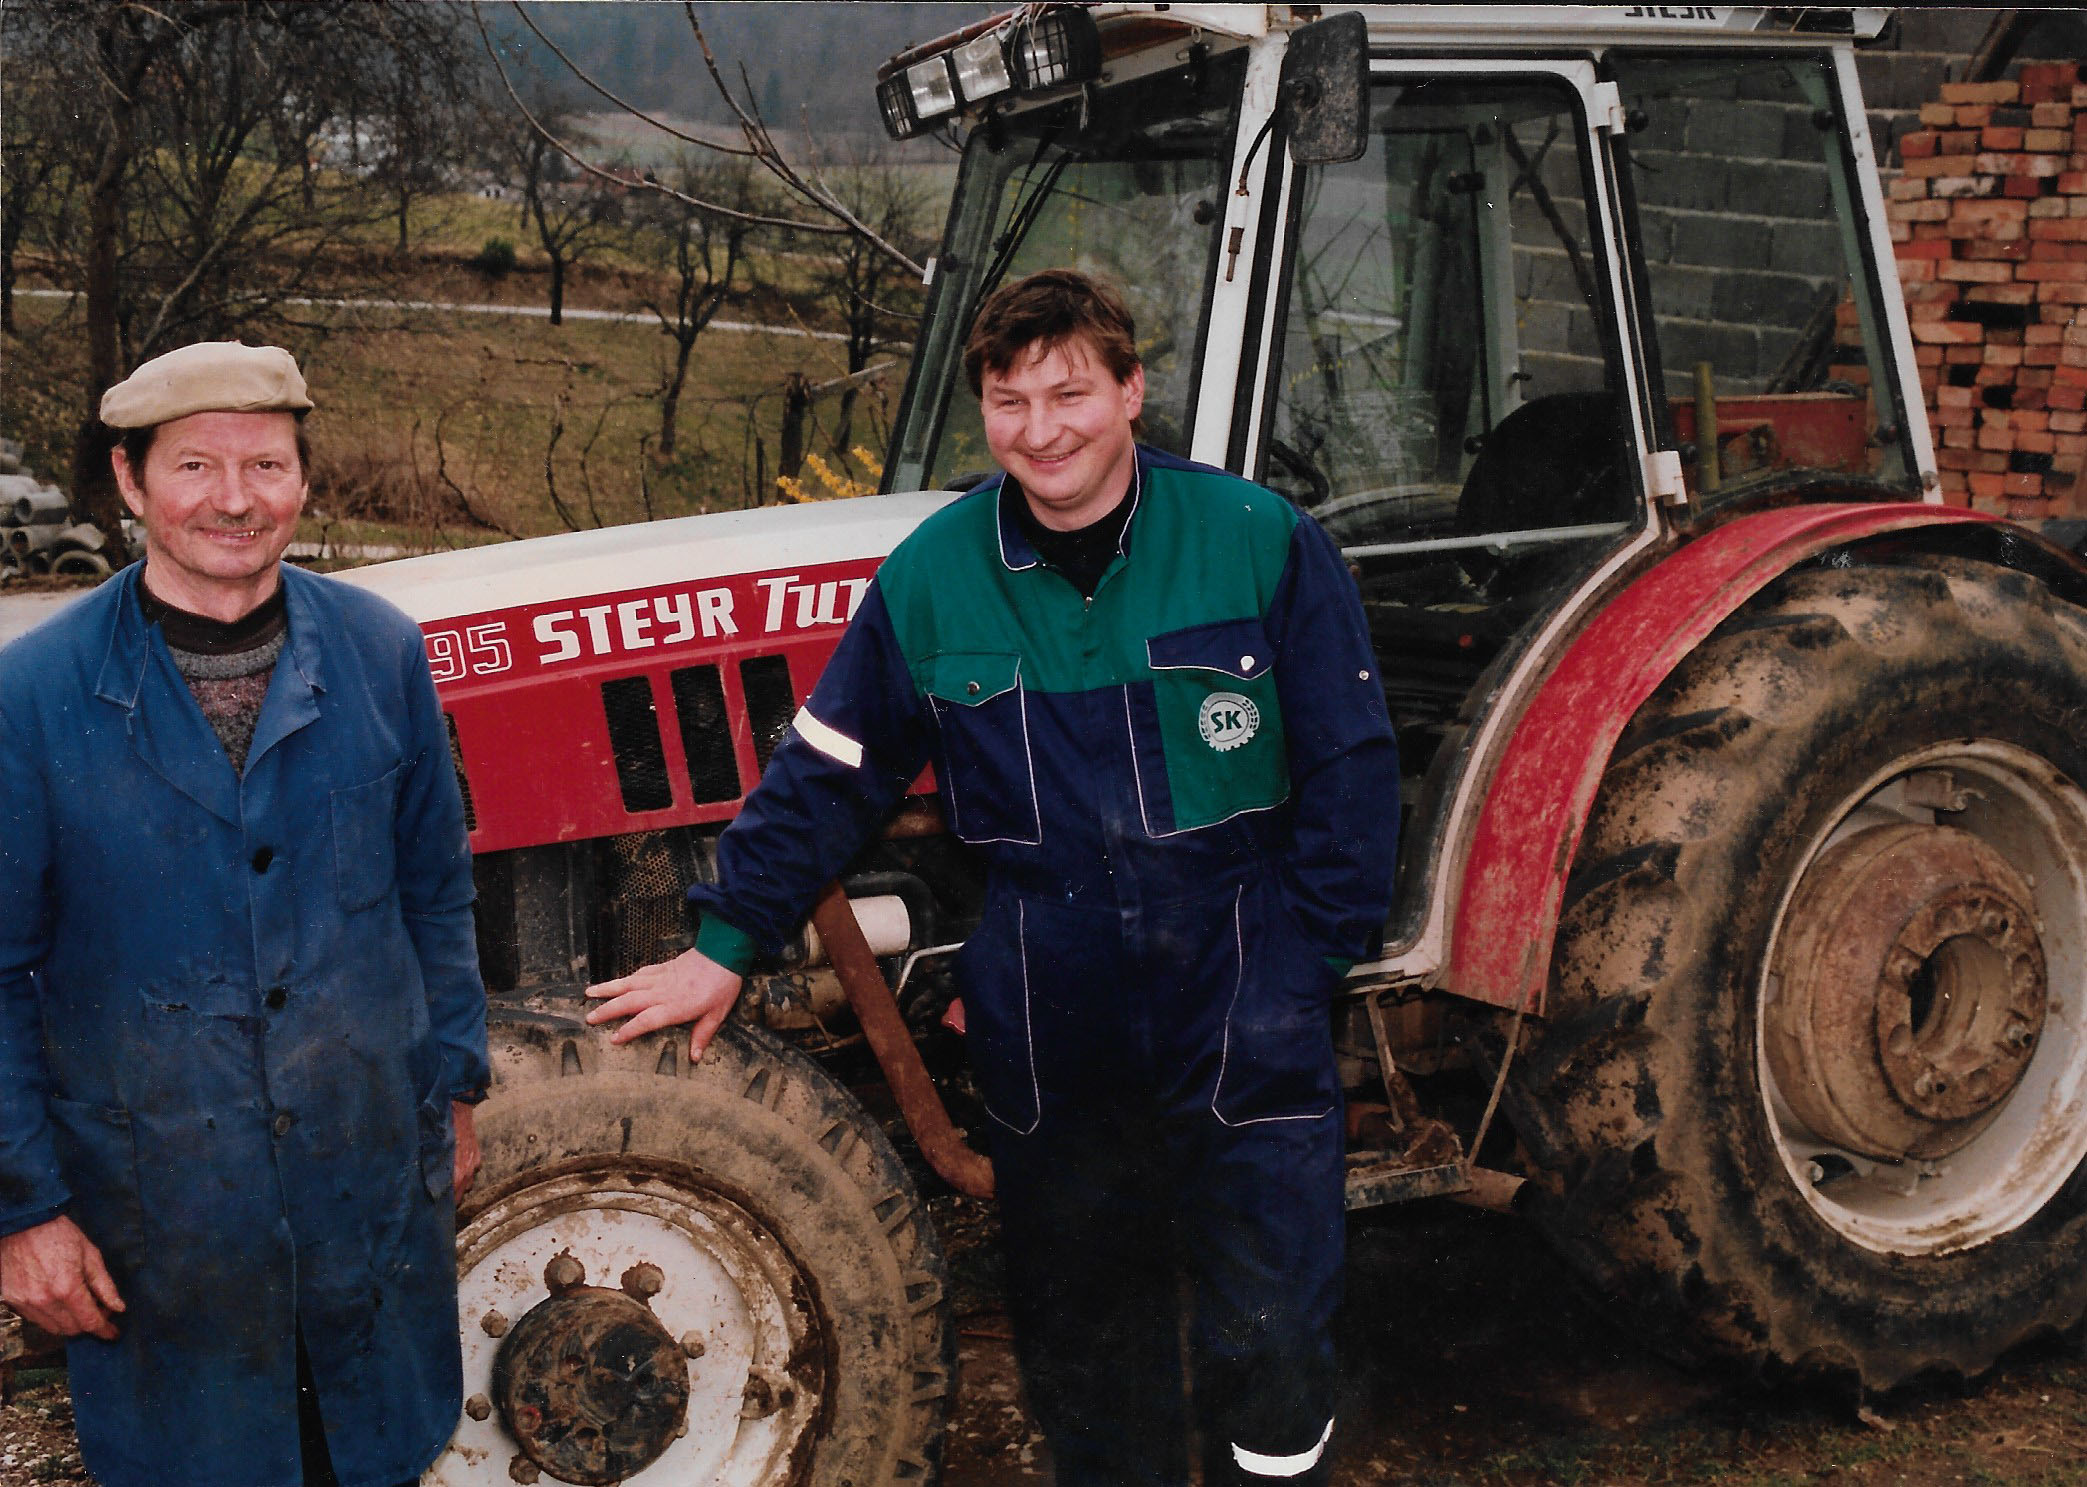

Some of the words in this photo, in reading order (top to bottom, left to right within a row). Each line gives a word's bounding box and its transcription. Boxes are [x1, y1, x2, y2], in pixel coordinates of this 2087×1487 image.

[423, 621, 513, 684] 95
[533, 587, 739, 665] STEYR
[1210, 710, 1243, 734] SK
